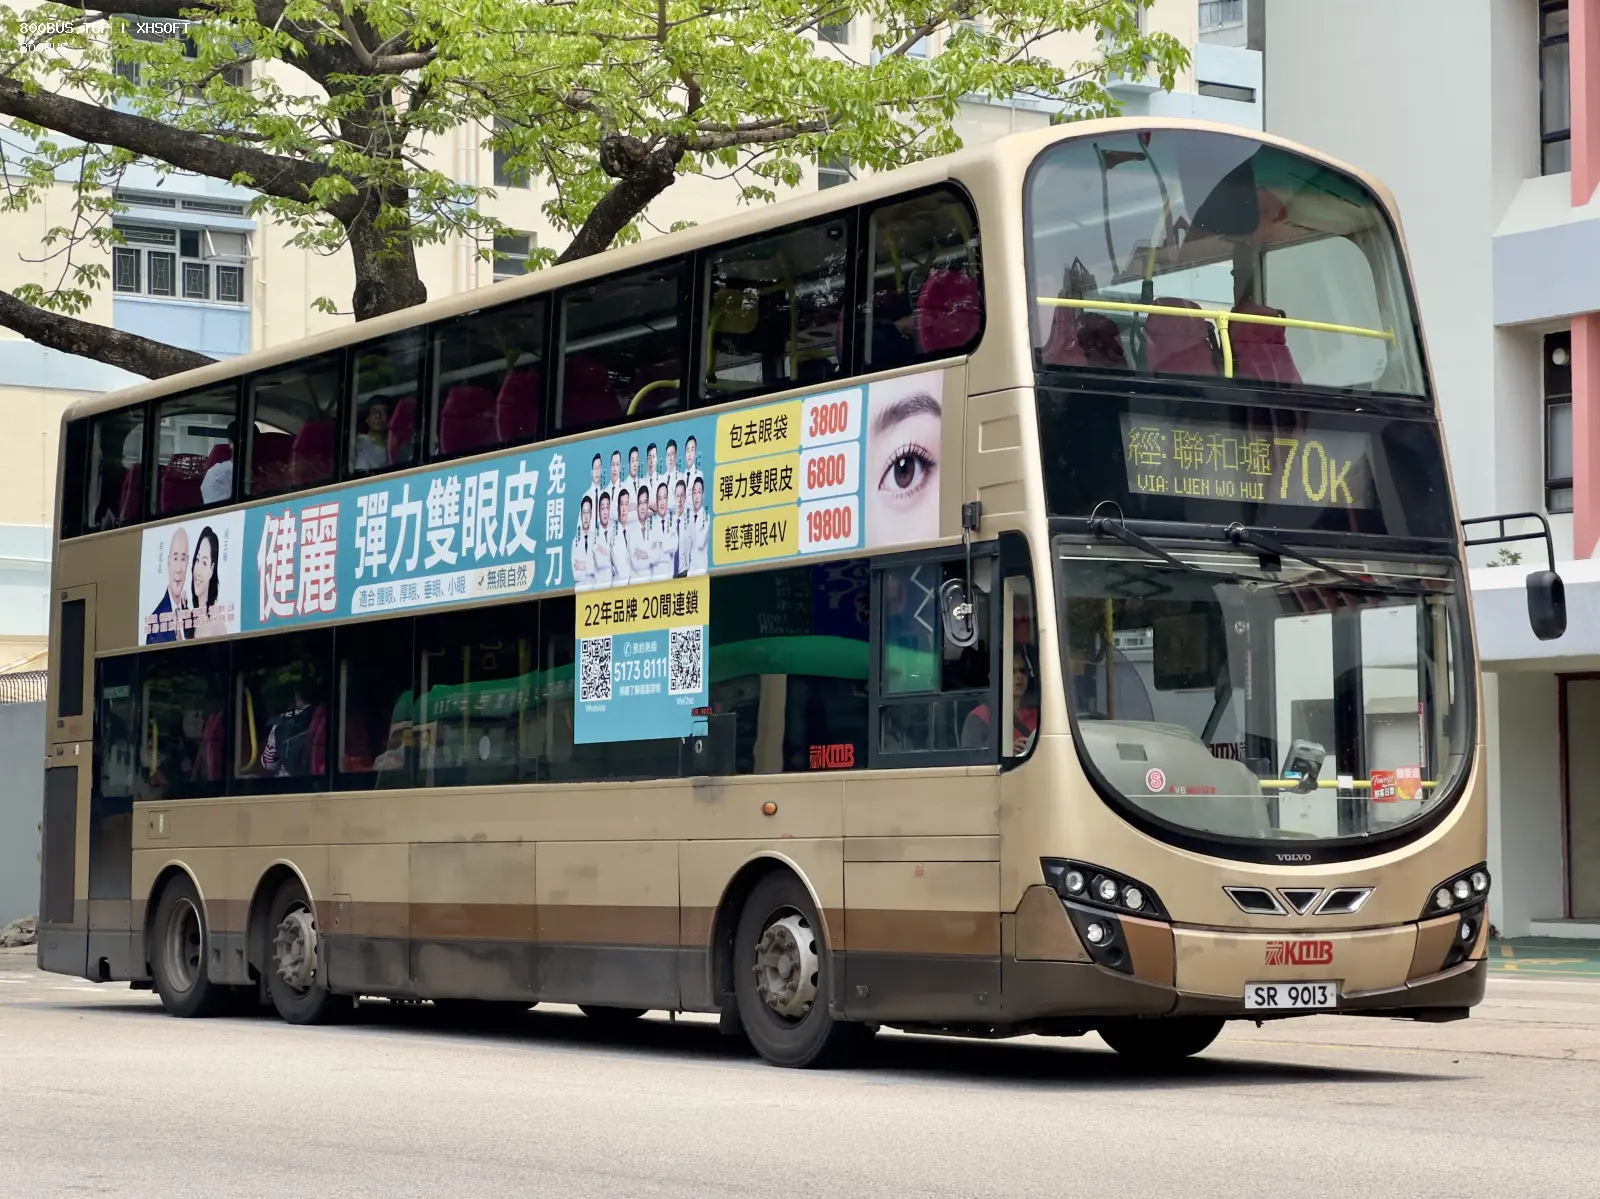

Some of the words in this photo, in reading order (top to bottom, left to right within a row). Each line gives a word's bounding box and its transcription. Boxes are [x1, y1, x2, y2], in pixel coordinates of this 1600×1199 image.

[730, 414, 788, 449] 包去眼袋
[809, 400, 848, 438] 3800
[719, 465, 793, 501] 彈力雙眼皮
[807, 453, 846, 490] 6800
[1137, 474, 1168, 492] VIA:
[1174, 477, 1210, 495] LUEN
[1215, 480, 1235, 498] WO
[1240, 482, 1264, 499] HUI
[1274, 438, 1354, 503] 70K
[355, 460, 539, 580] 彈力雙眼皮
[545, 452, 566, 587] 免開刀
[724, 520, 787, 552] 輕薄眼4V
[806, 506, 852, 543] 19800
[256, 501, 341, 624] 健麗
[486, 565, 528, 590] 無痕自然
[584, 595, 639, 627] 22年品牌
[642, 590, 699, 619] 20間連鎖
[614, 660, 641, 682] 5173
[643, 657, 668, 679] 8111
[822, 743, 854, 769] KMB
[1276, 853, 1312, 861] VOLVO
[1285, 940, 1334, 966] KMB
[1254, 986, 1279, 1006] SR
[1288, 985, 1328, 1006] 9013
